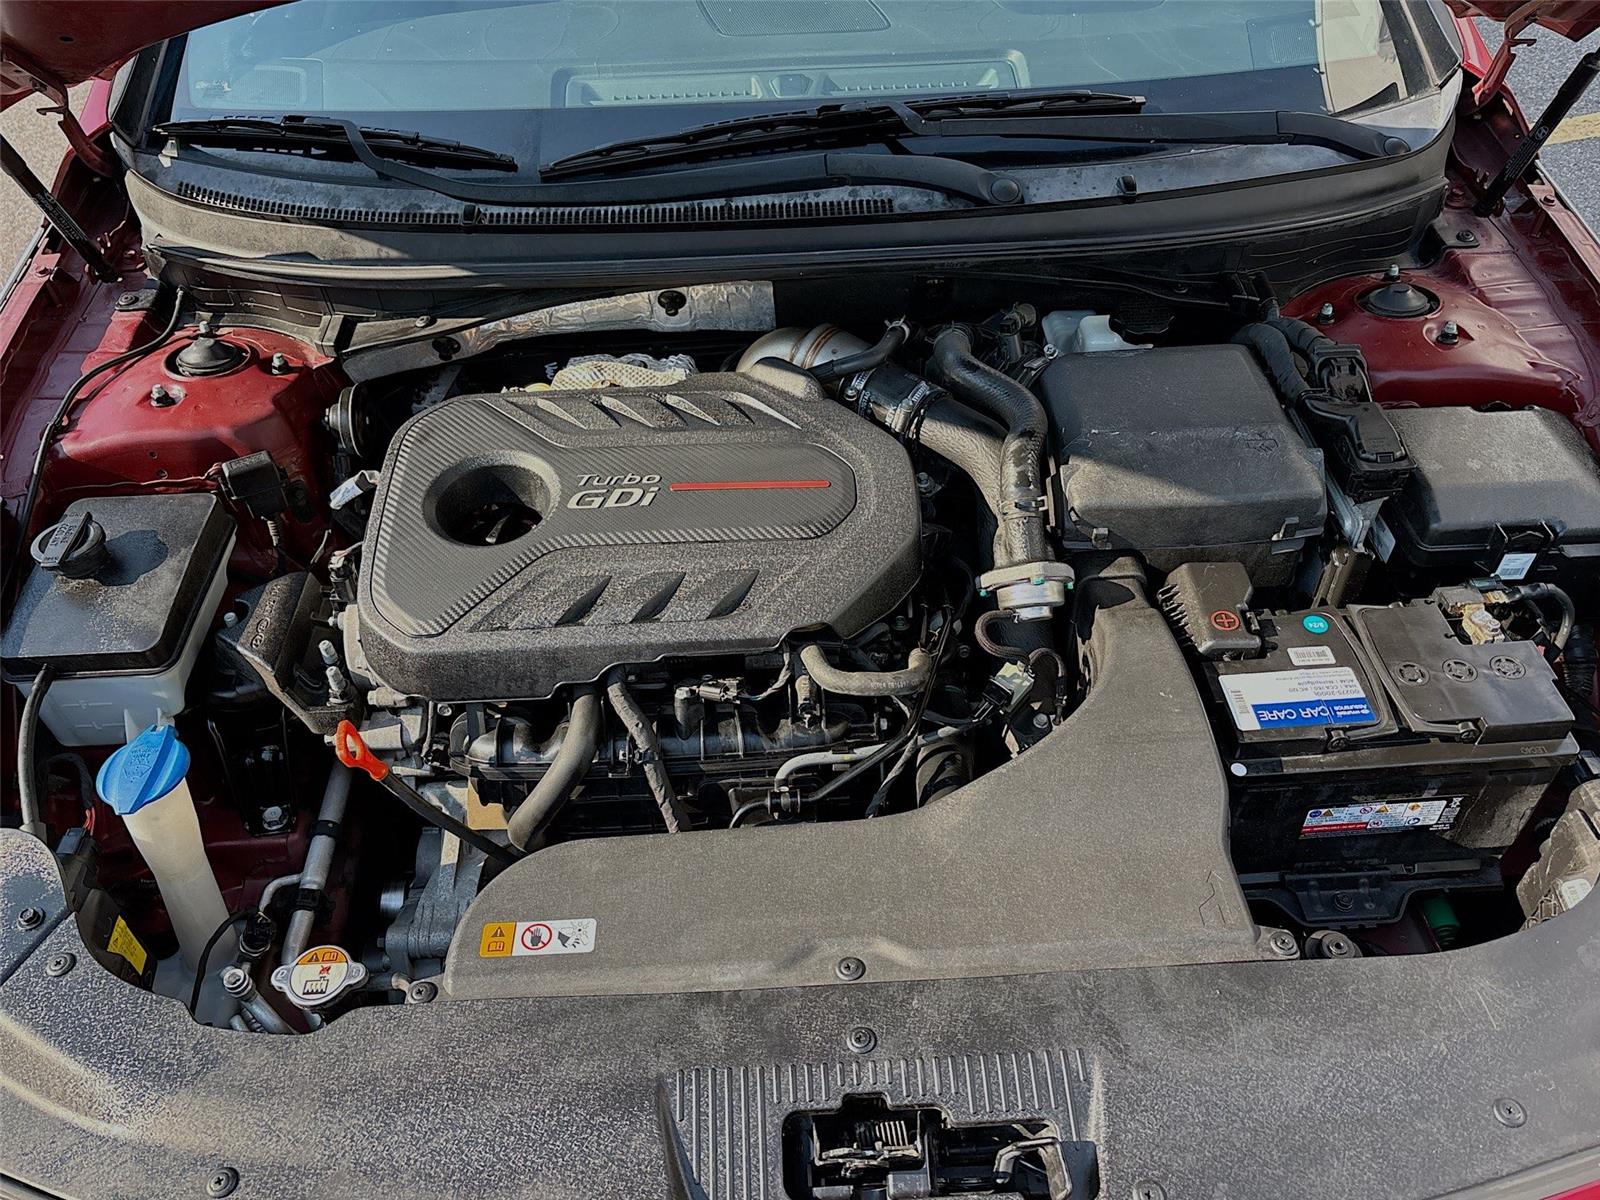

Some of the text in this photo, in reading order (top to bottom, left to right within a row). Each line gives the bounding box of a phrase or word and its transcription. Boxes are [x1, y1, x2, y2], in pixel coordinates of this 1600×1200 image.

[577, 473, 661, 487] Turbo
[567, 487, 660, 509] GDi
[1257, 708, 1297, 721] CARE
[1300, 706, 1330, 717] CAR
